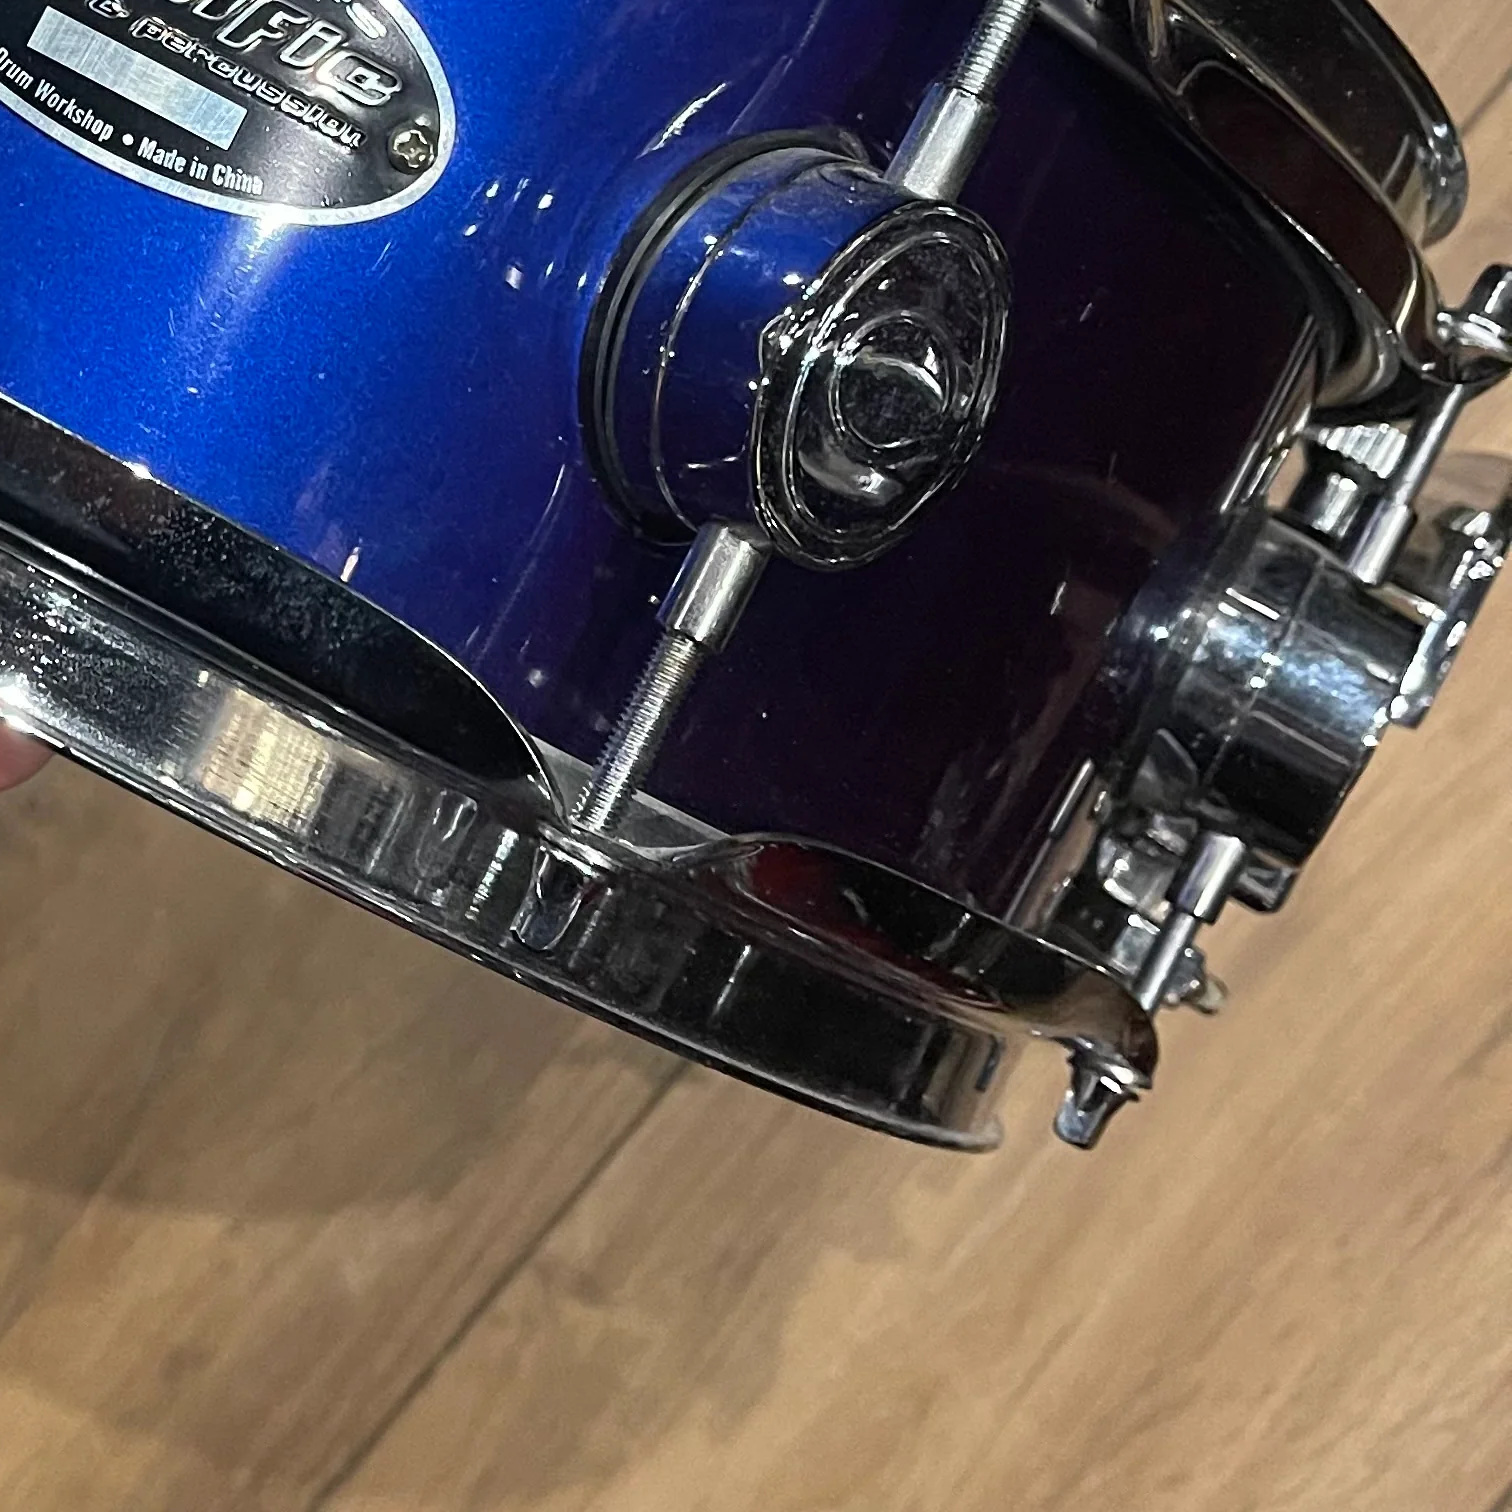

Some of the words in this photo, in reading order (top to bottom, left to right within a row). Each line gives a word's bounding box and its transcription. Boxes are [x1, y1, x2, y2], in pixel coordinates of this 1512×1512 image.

[34, 78, 115, 143] Workshop
[136, 136, 188, 174] Made
[189, 155, 210, 182] in
[211, 162, 265, 196] China
[129, 15, 367, 152] percussion
